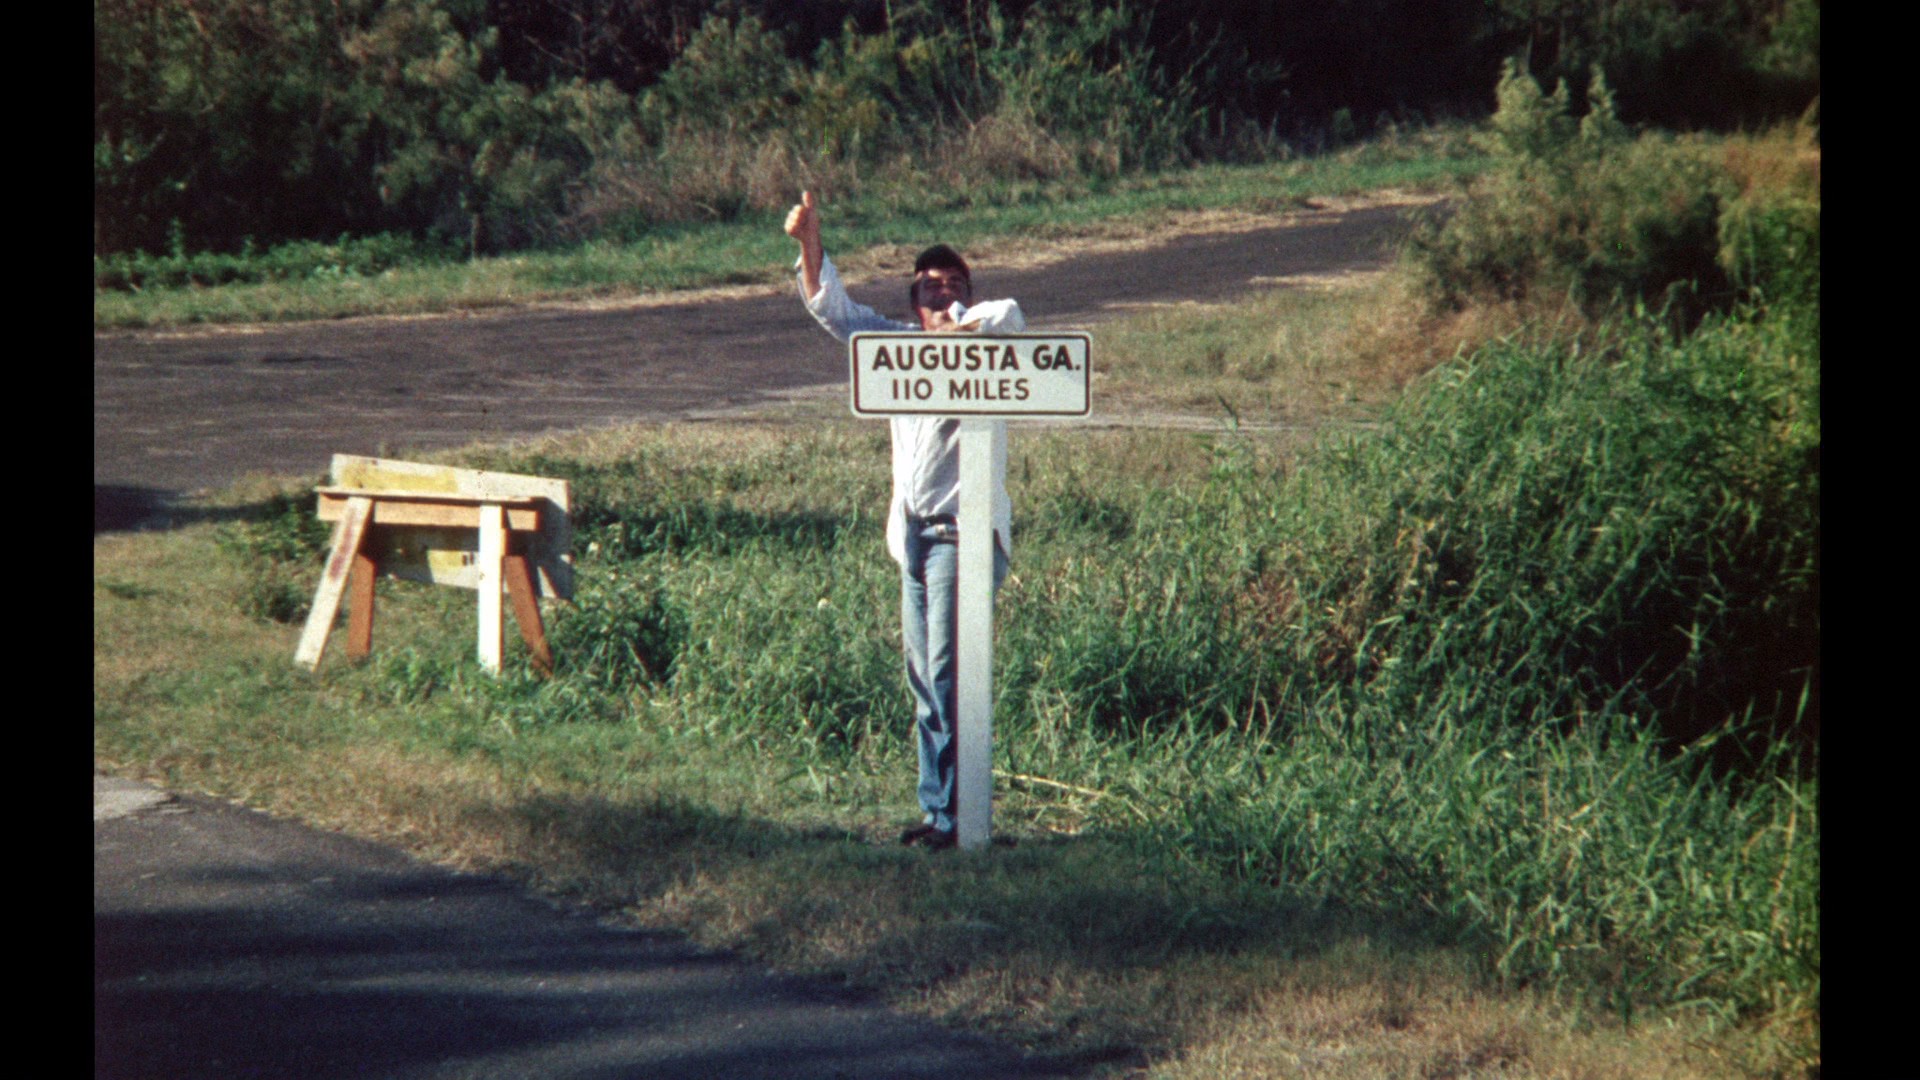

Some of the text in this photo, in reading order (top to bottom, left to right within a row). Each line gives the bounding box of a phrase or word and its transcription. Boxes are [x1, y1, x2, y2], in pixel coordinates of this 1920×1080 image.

[872, 344, 1081, 371] AUGUSTA GA.
[892, 378, 1030, 400] 110 MILES
